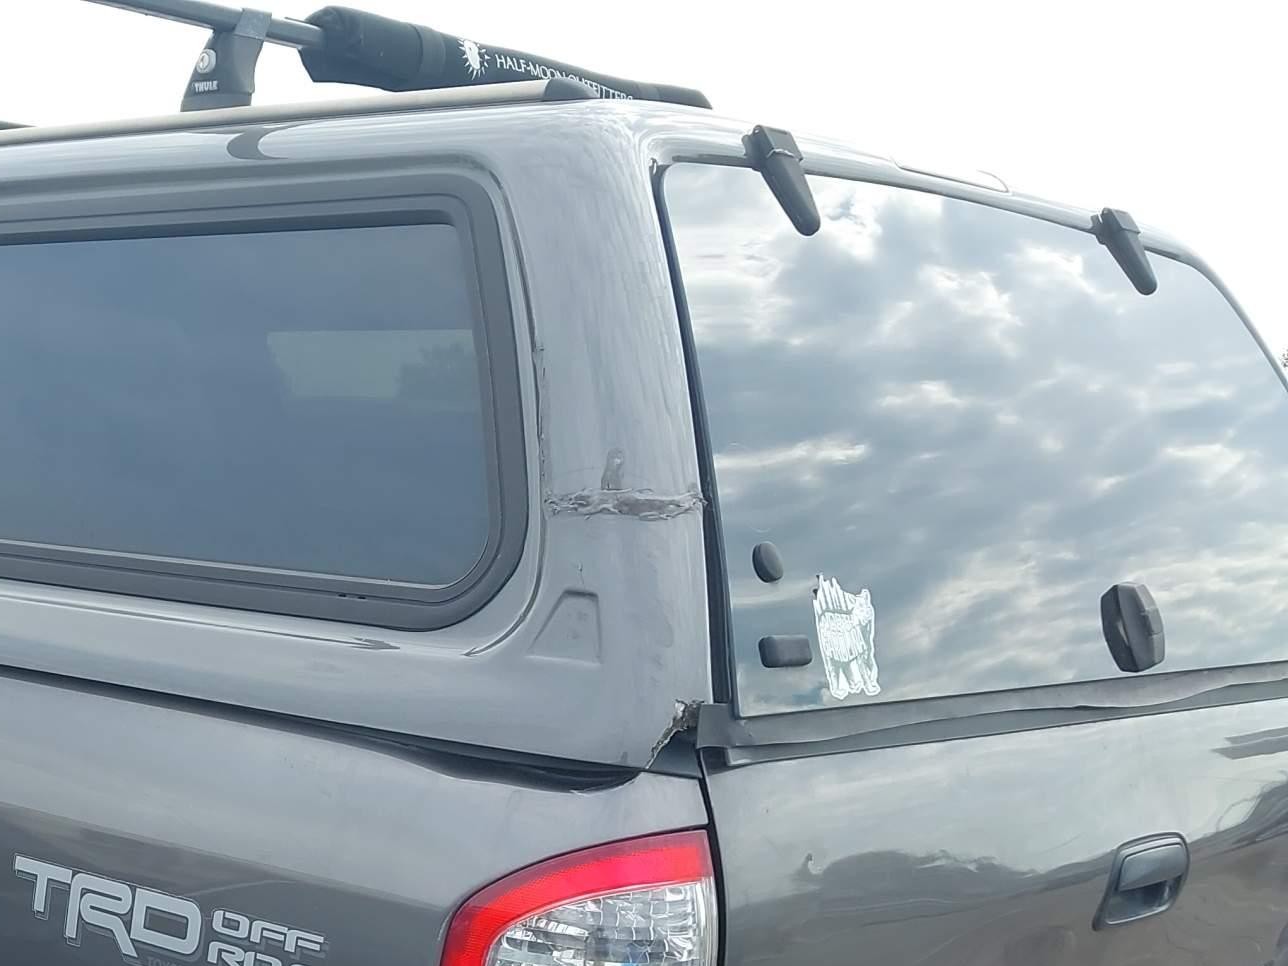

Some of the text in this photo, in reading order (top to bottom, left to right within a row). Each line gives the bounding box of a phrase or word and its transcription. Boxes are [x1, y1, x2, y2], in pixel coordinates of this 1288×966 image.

[194, 80, 218, 93] THULE
[14, 855, 202, 958] TRD
[212, 910, 325, 953] OFF
